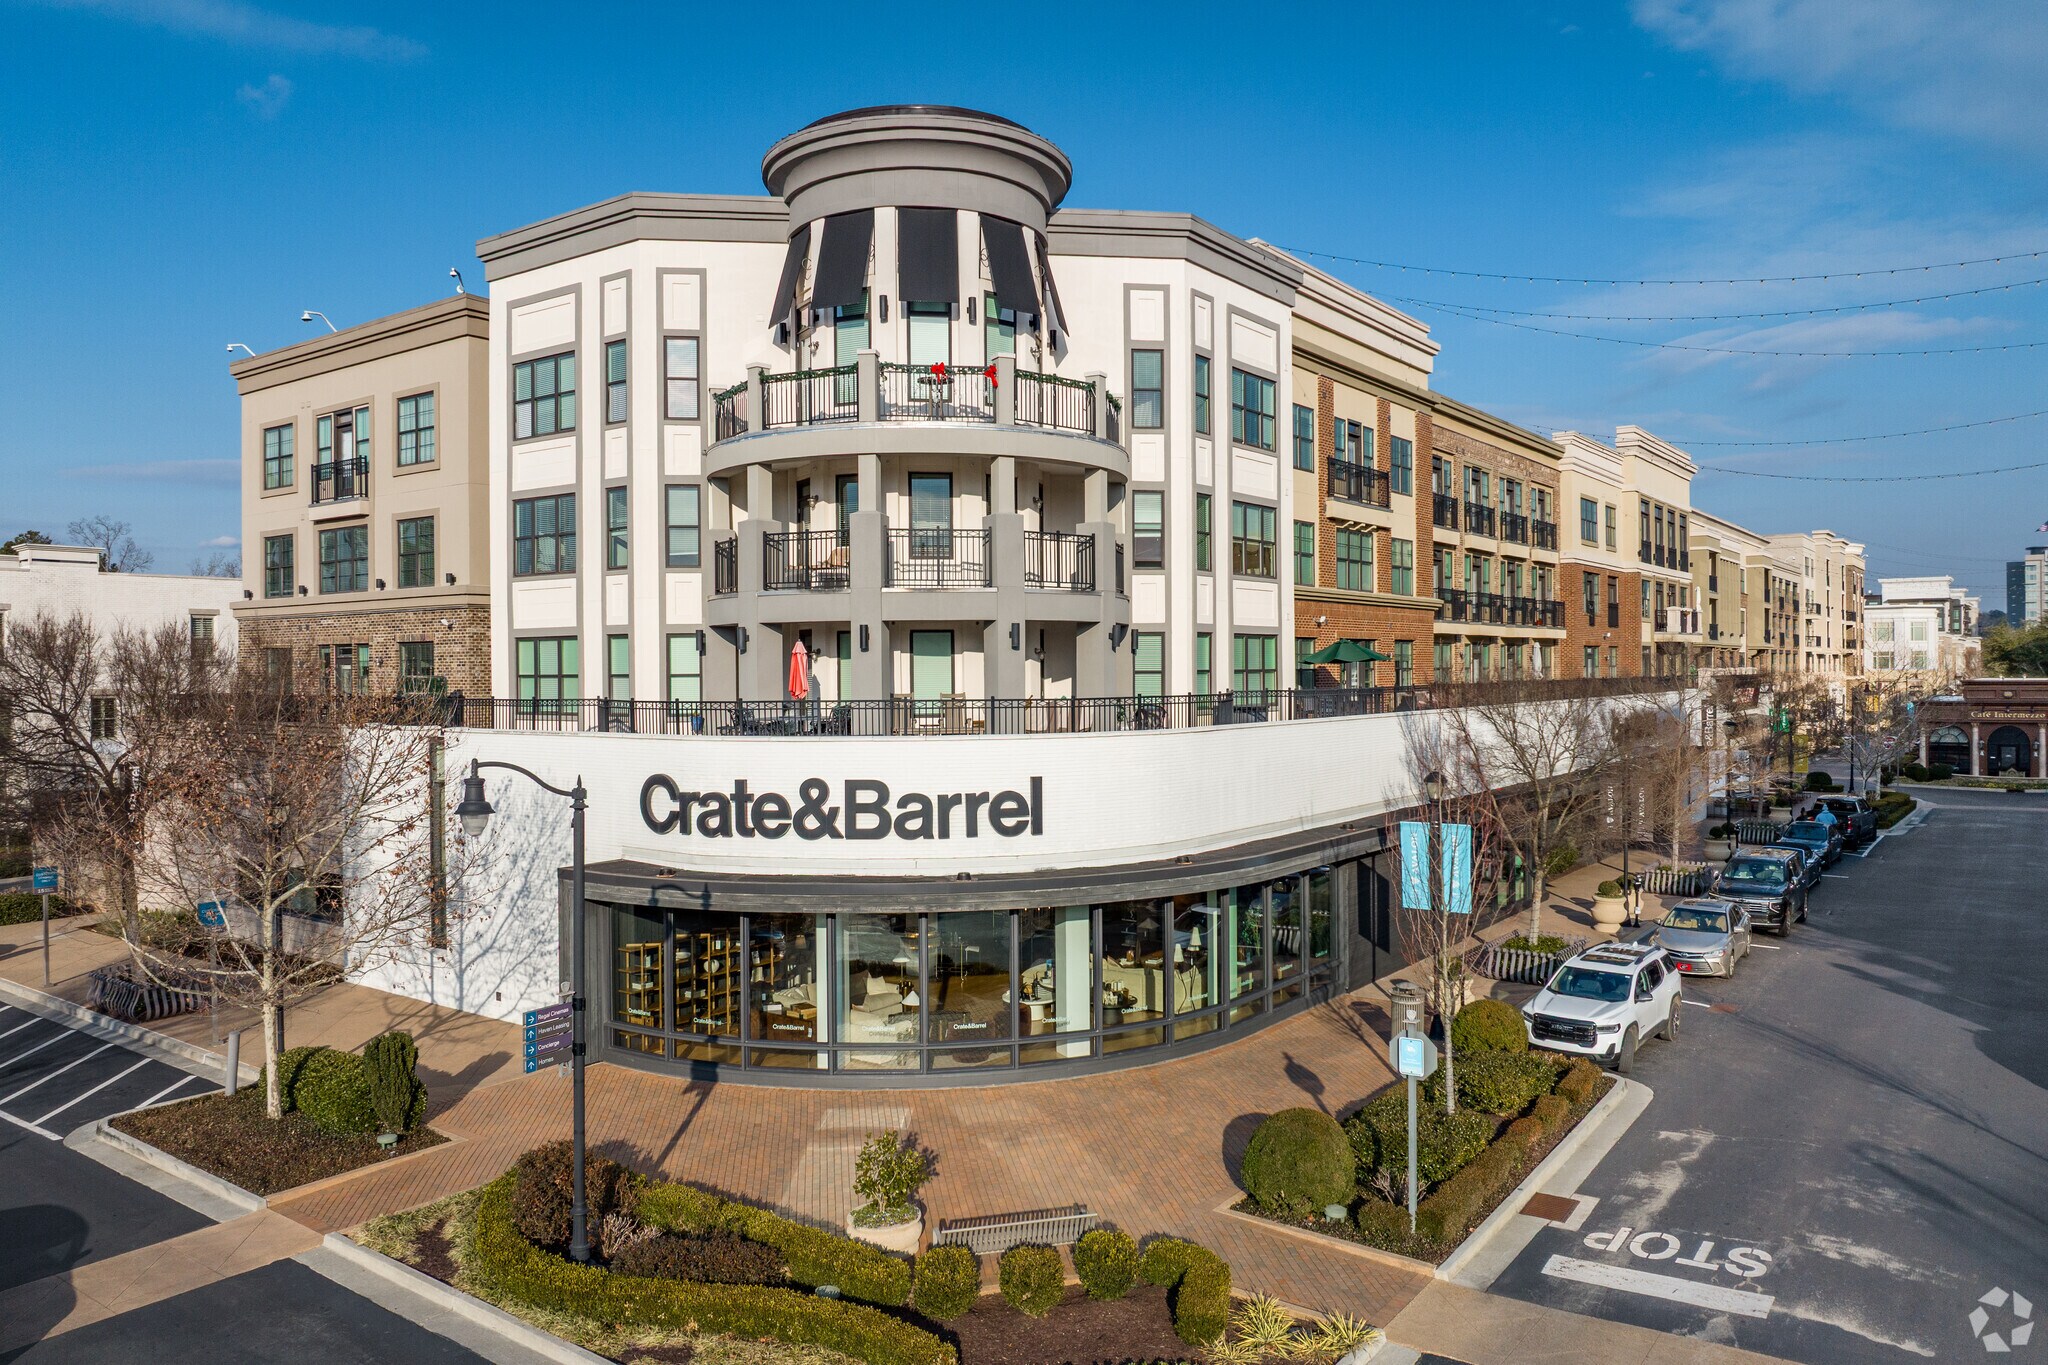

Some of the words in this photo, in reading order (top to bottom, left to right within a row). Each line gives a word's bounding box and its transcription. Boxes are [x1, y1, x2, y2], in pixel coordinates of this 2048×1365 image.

[640, 773, 1043, 840] Crate&Barrel
[1410, 832, 1419, 874] AVALON
[538, 1012, 550, 1020] Regal
[551, 1007, 569, 1016] Cinemas
[538, 1026, 552, 1034] Haven
[553, 1021, 570, 1030] Leasing
[772, 1023, 805, 1031] Crate&Barrel
[953, 1022, 987, 1030] Crate&Barrel
[538, 1040, 560, 1051] Concierge
[539, 1056, 554, 1065] Homes
[1583, 1227, 1773, 1278] STOP
